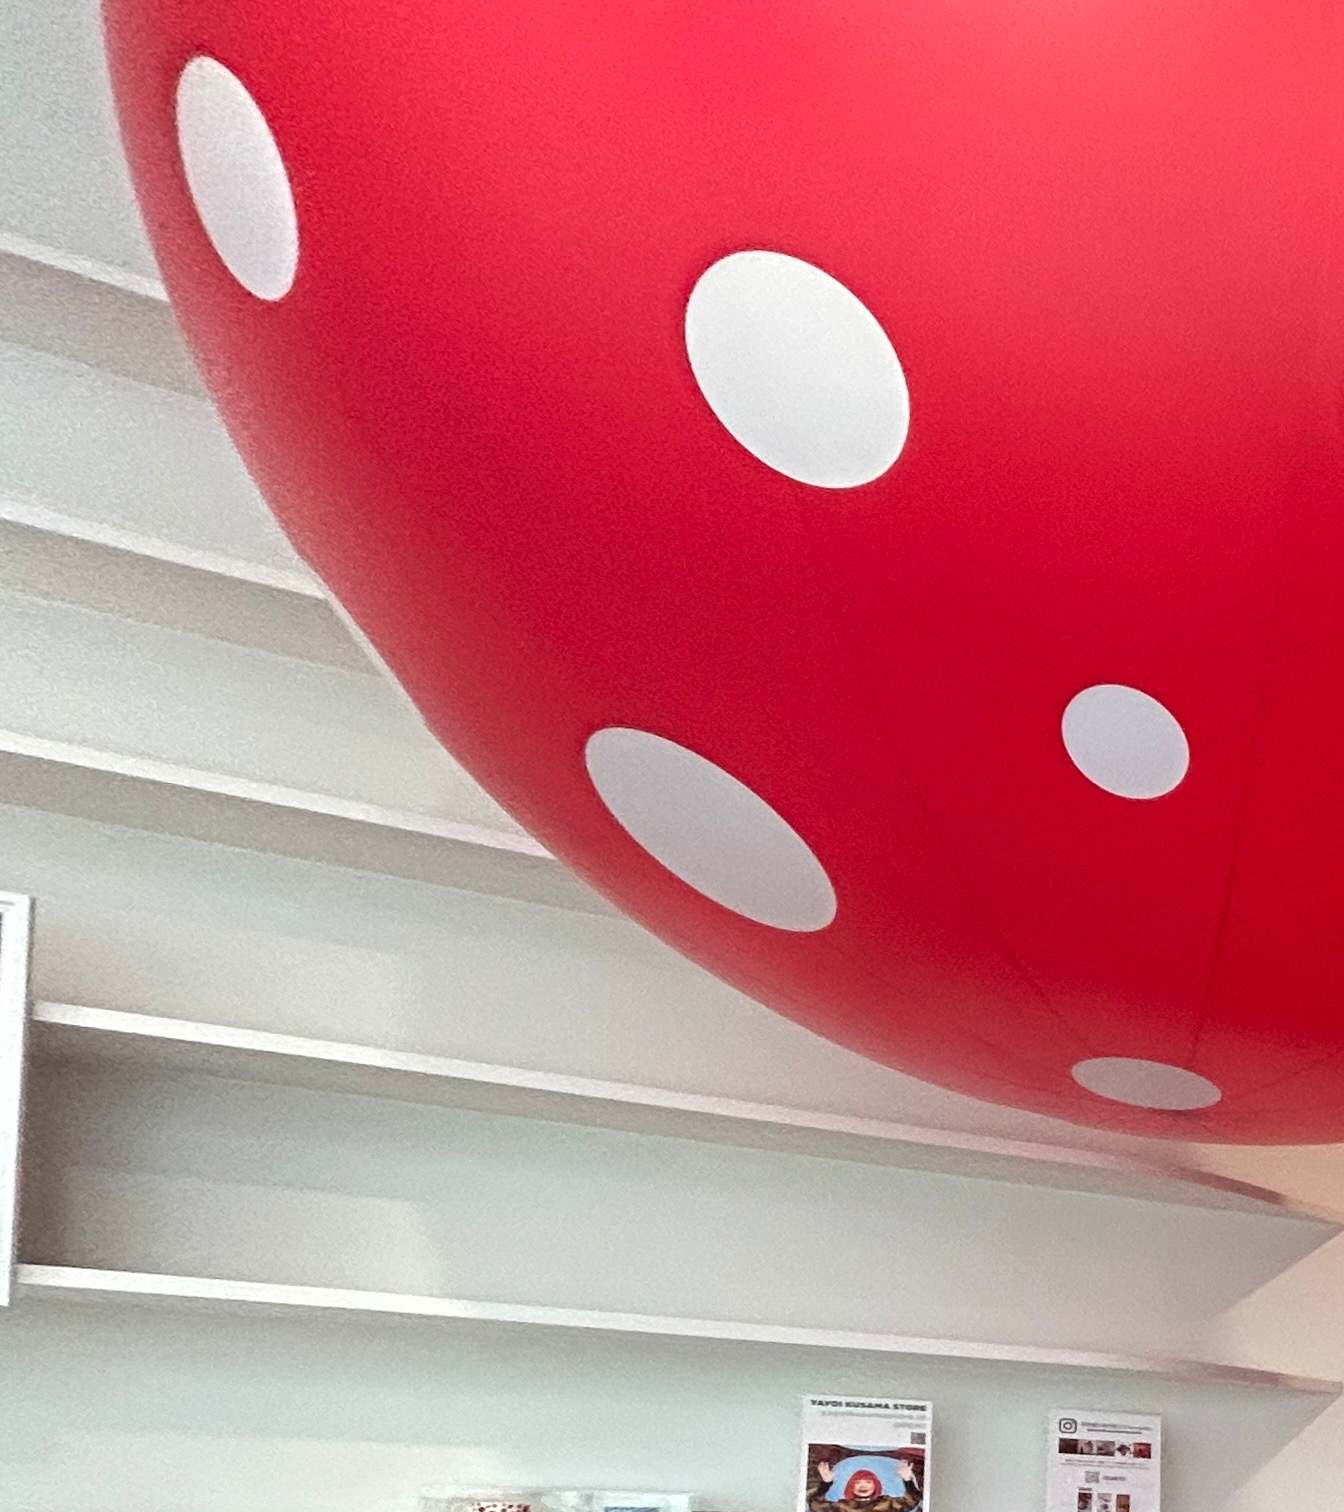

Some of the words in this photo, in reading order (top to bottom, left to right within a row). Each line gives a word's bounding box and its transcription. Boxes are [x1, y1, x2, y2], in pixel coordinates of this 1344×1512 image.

[810, 1399, 842, 1407] YAYOI
[845, 1401, 890, 1409] KUSAMA
[892, 1403, 927, 1412] STORE
